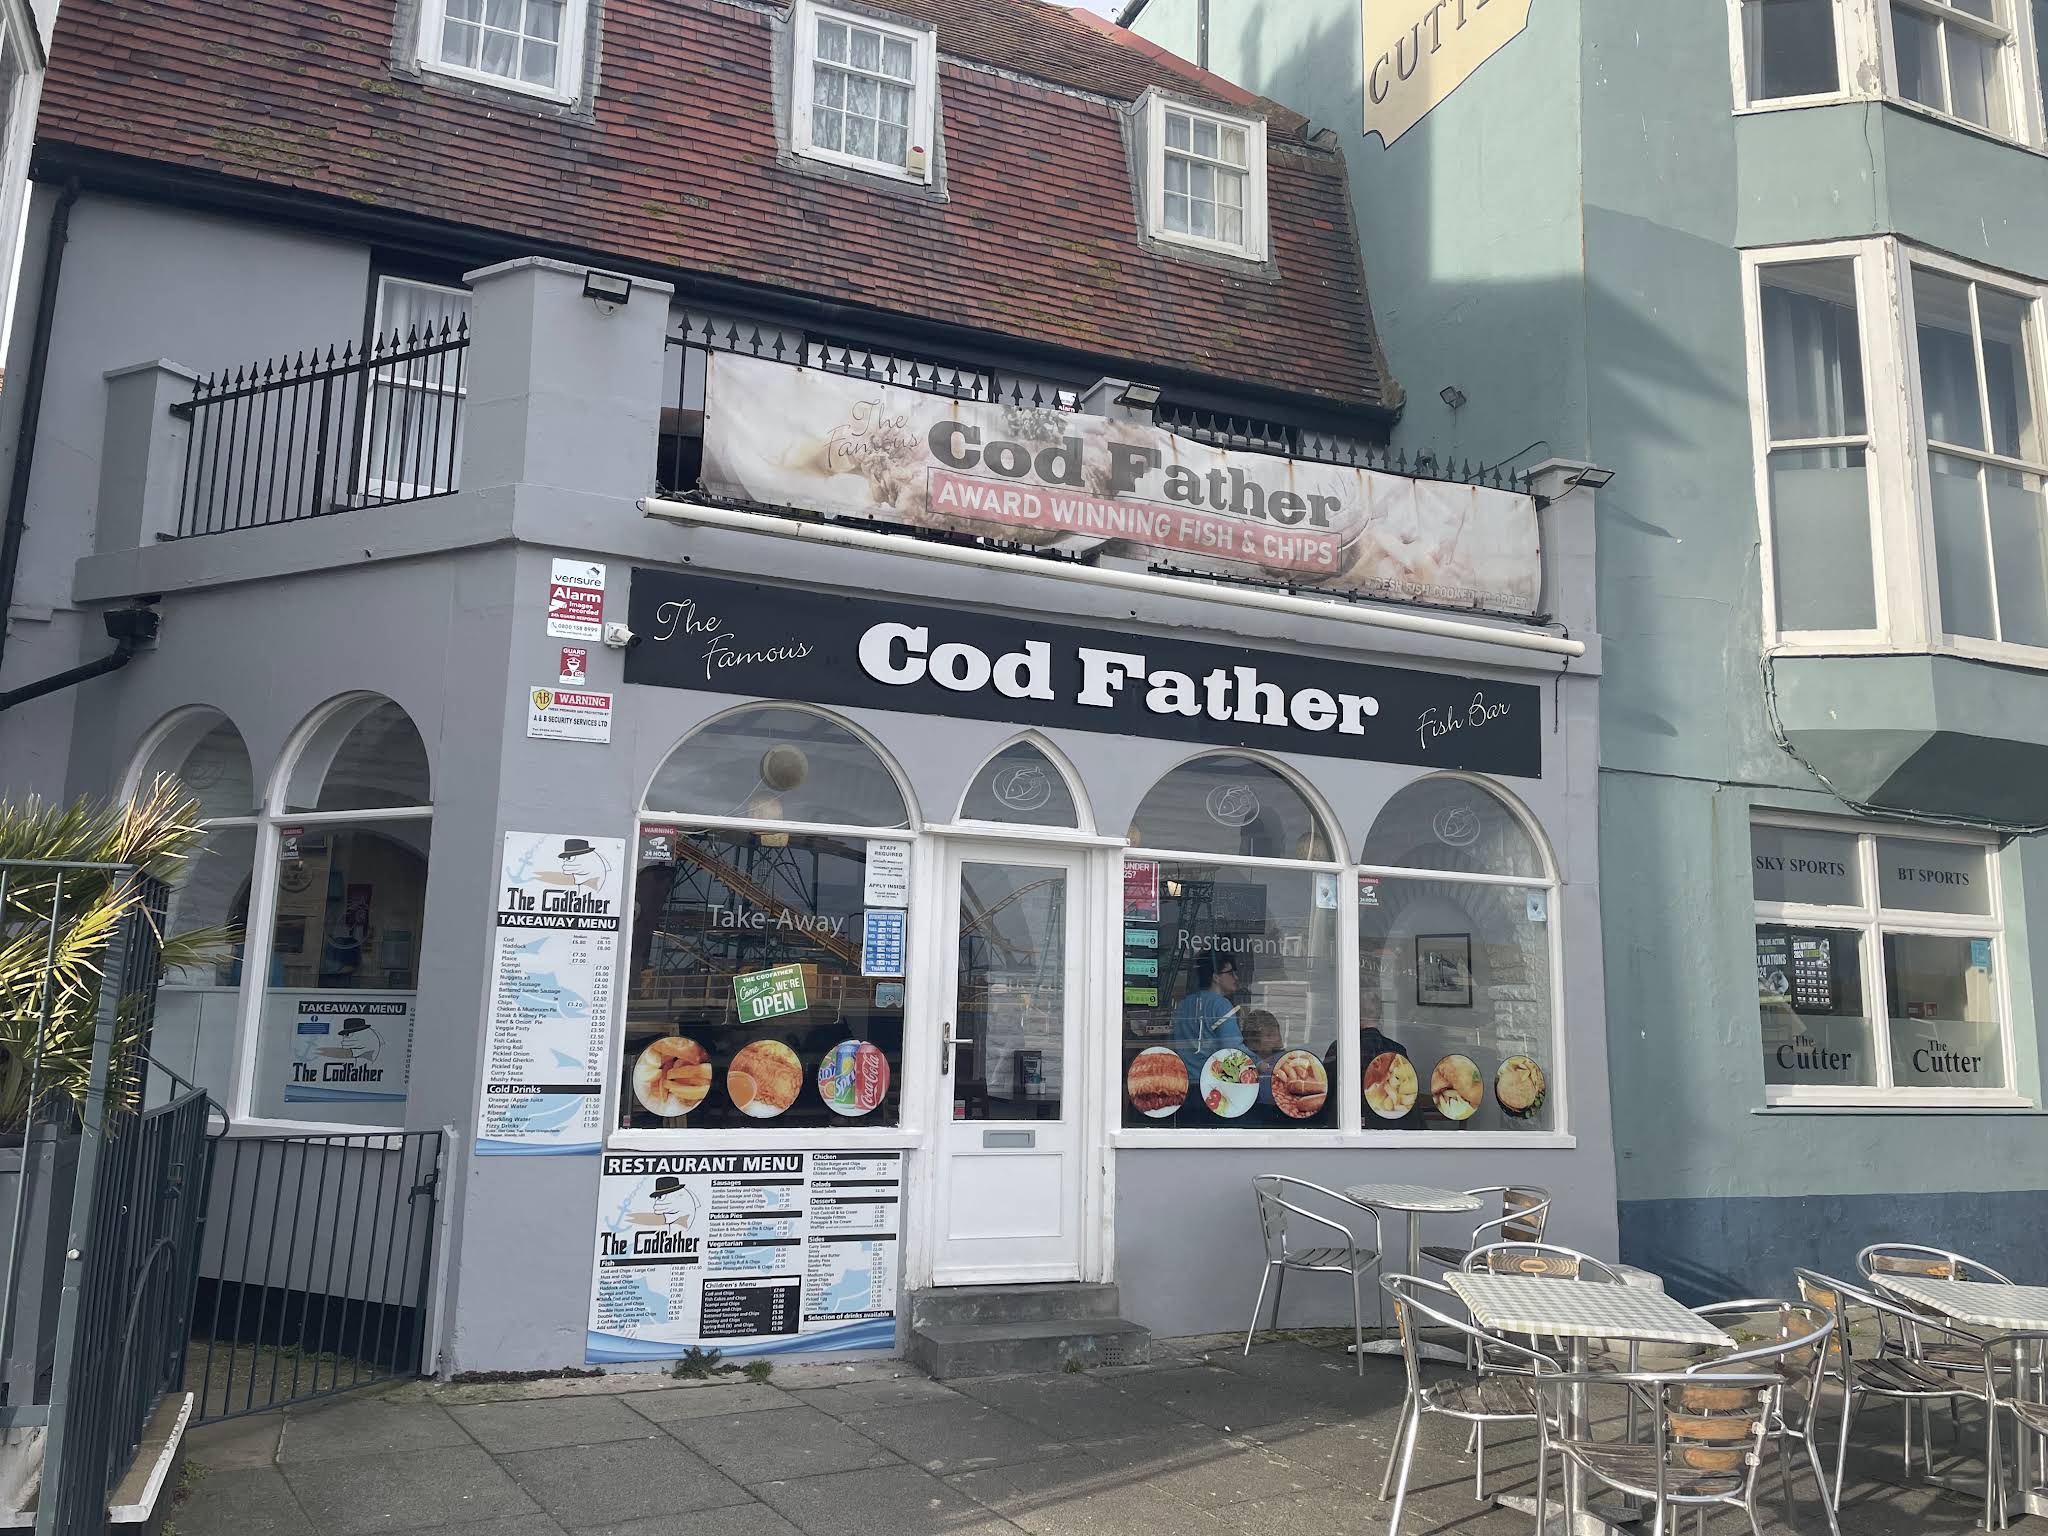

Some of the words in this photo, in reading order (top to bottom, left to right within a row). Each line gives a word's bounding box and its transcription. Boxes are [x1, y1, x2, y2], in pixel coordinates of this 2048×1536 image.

[1370, 0, 1490, 104] CUTT
[852, 398, 909, 438] The
[823, 425, 923, 468] Famous
[927, 420, 1085, 488] Cod
[1107, 442, 1341, 527] Father
[938, 479, 1042, 518] AWARD
[1050, 500, 1171, 537] WINNING
[1179, 518, 1233, 550] FISH
[1240, 529, 1257, 553] &
[1263, 534, 1332, 565] CHIPS
[554, 574, 601, 587] verisure
[552, 587, 601, 603] Alarm
[1405, 582, 1431, 596] FISH
[1433, 585, 1476, 599] COOKED
[1494, 592, 1528, 608] ORDER
[568, 606, 599, 616] recorded
[569, 601, 593, 610] Images
[653, 598, 722, 641] The
[701, 633, 814, 681] Famous
[563, 647, 586, 655] GUARD
[857, 622, 1055, 700] Cod
[1076, 646, 1379, 735] Father
[559, 694, 606, 707] WARNING
[533, 714, 538, 722] A
[548, 716, 573, 725] SECURITY
[574, 718, 597, 727] SERVICES
[598, 720, 608, 728] LTD
[1416, 705, 1464, 750] Fish
[1468, 691, 1511, 727] Bar
[644, 827, 674, 835] WARNING
[1123, 863, 1150, 871] UNDER
[1755, 855, 1785, 871] SKY
[1789, 858, 1845, 876] SPORTS
[1123, 871, 1137, 879] 25?
[1897, 867, 1914, 881] BT
[1919, 869, 1970, 886] SPORTS
[507, 887, 535, 911] The
[541, 889, 611, 914] Codfather
[499, 914, 576, 928] TAKEAWAY
[577, 918, 617, 930] MENU
[707, 904, 845, 938] Take-Away
[1178, 929, 1284, 955] Restaurant
[1762, 954, 1787, 966] NATIONS
[756, 968, 794, 981] CODFATHER
[739, 985, 760, 1001] Come
[775, 977, 801, 991] WE'RE
[300, 1003, 367, 1013] TAKEAWAY
[369, 1004, 404, 1014] MENU
[751, 991, 796, 1017] OPEN
[1791, 1034, 1815, 1050] The
[1926, 1040, 1947, 1055] The
[1775, 1045, 1851, 1071] Cutter
[1912, 1048, 1981, 1073] Cutter
[292, 1062, 318, 1082] The
[322, 1062, 384, 1082] Codfather
[489, 1085, 510, 1094] Cold
[512, 1085, 541, 1094] Drinks
[608, 1157, 743, 1174] RESTAURANT
[743, 1156, 800, 1173] MENU
[600, 1232, 628, 1256] The
[633, 1231, 700, 1255] Codfather
[708, 1240, 743, 1248] Vegetarian
[705, 1281, 737, 1289] Children's
[863, 1311, 890, 1319] available
